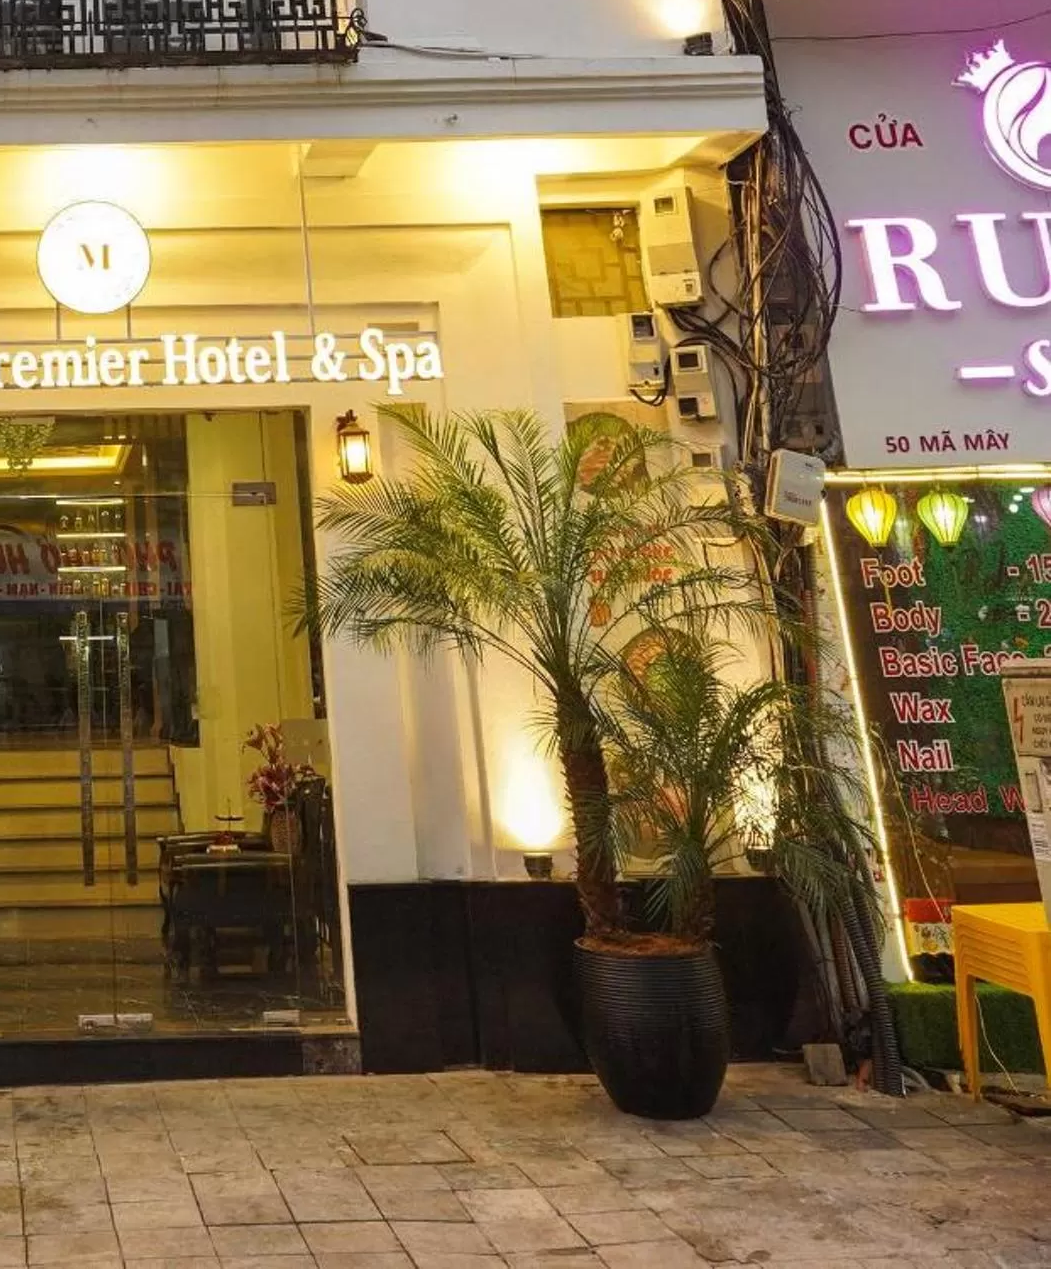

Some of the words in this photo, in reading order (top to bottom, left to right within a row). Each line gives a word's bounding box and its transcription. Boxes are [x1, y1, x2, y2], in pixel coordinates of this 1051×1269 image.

[849, 113, 923, 150] CỬA
[160, 331, 290, 385] Hotel
[311, 333, 347, 381] &
[359, 328, 444, 395] Spa
[885, 436, 910, 453] 50
[920, 431, 955, 453] MÃ
[964, 430, 1010, 451] MÂY
[860, 558, 926, 588] Foot
[870, 601, 941, 637] Body
[880, 645, 957, 678] Basic
[890, 691, 954, 724] Wax
[897, 738, 953, 772] Nail
[909, 784, 989, 815] Head
